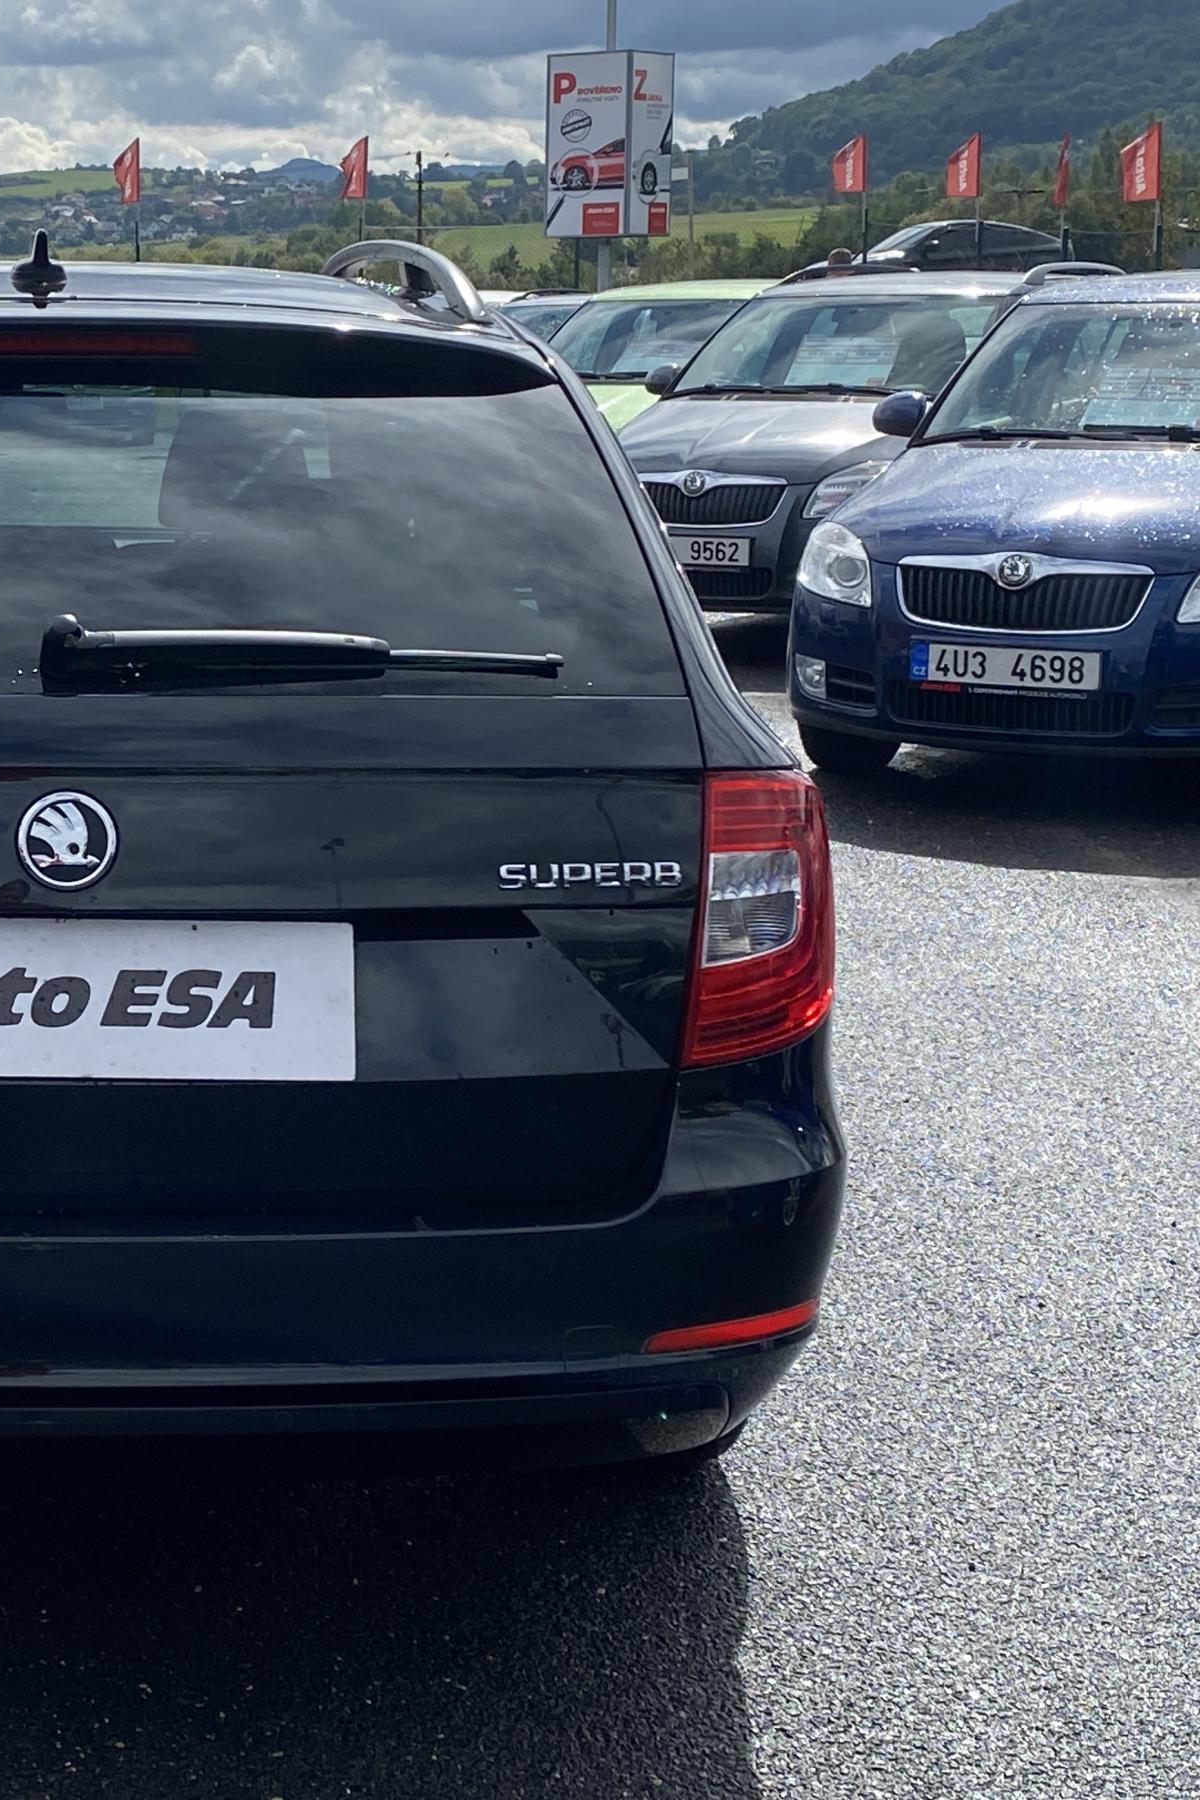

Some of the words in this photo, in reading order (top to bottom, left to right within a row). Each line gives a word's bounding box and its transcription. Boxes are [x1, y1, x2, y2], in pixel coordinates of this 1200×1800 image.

[691, 540, 739, 562] 9562
[912, 666, 927, 676] CZ
[935, 649, 987, 679] 4U3
[1011, 653, 1085, 685] 4698
[499, 861, 682, 889] SUPERB
[99, 969, 277, 1029] ESA
